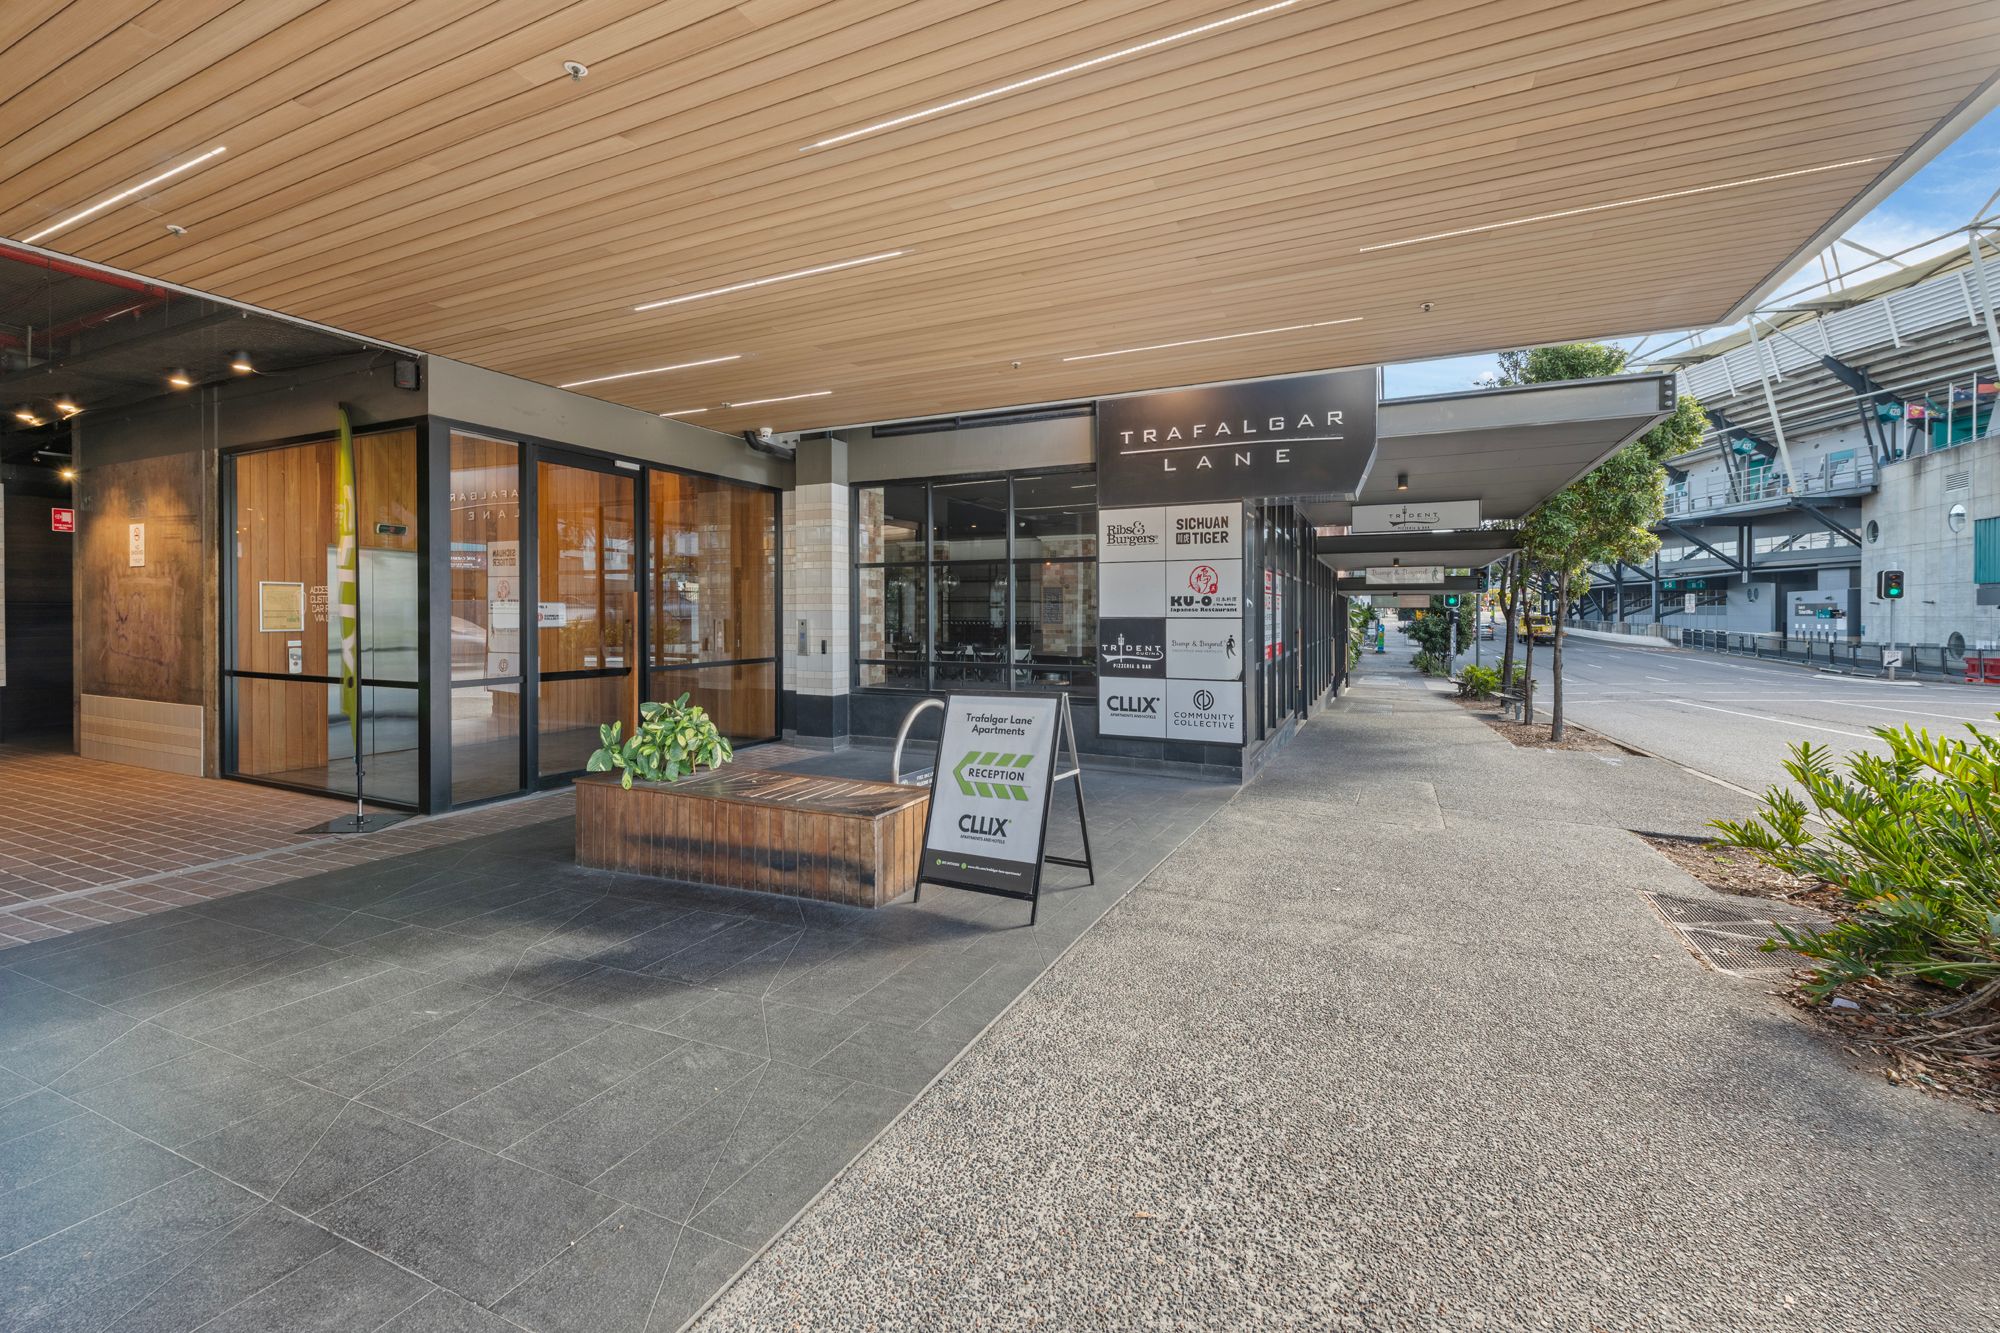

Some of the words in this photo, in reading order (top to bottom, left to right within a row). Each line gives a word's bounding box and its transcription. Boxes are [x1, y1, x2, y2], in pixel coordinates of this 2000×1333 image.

[1120, 411, 1344, 444] TRAFALGAR
[1164, 449, 1290, 472] LANE
[1176, 515, 1229, 530] SICHUAN
[1106, 534, 1156, 547] Burgers
[1192, 531, 1229, 544] TIGER
[1170, 596, 1212, 607] KU-O
[1106, 695, 1157, 714] CLLIX
[966, 712, 1009, 726] Trafalgar
[1010, 714, 1033, 725] Lane
[1174, 711, 1234, 721] COMMUNITY
[971, 724, 1025, 736] Apartments
[1174, 719, 1235, 729] COLLECTIVE
[968, 767, 1025, 781] RECEPTION
[958, 814, 1008, 837] CLLIX
